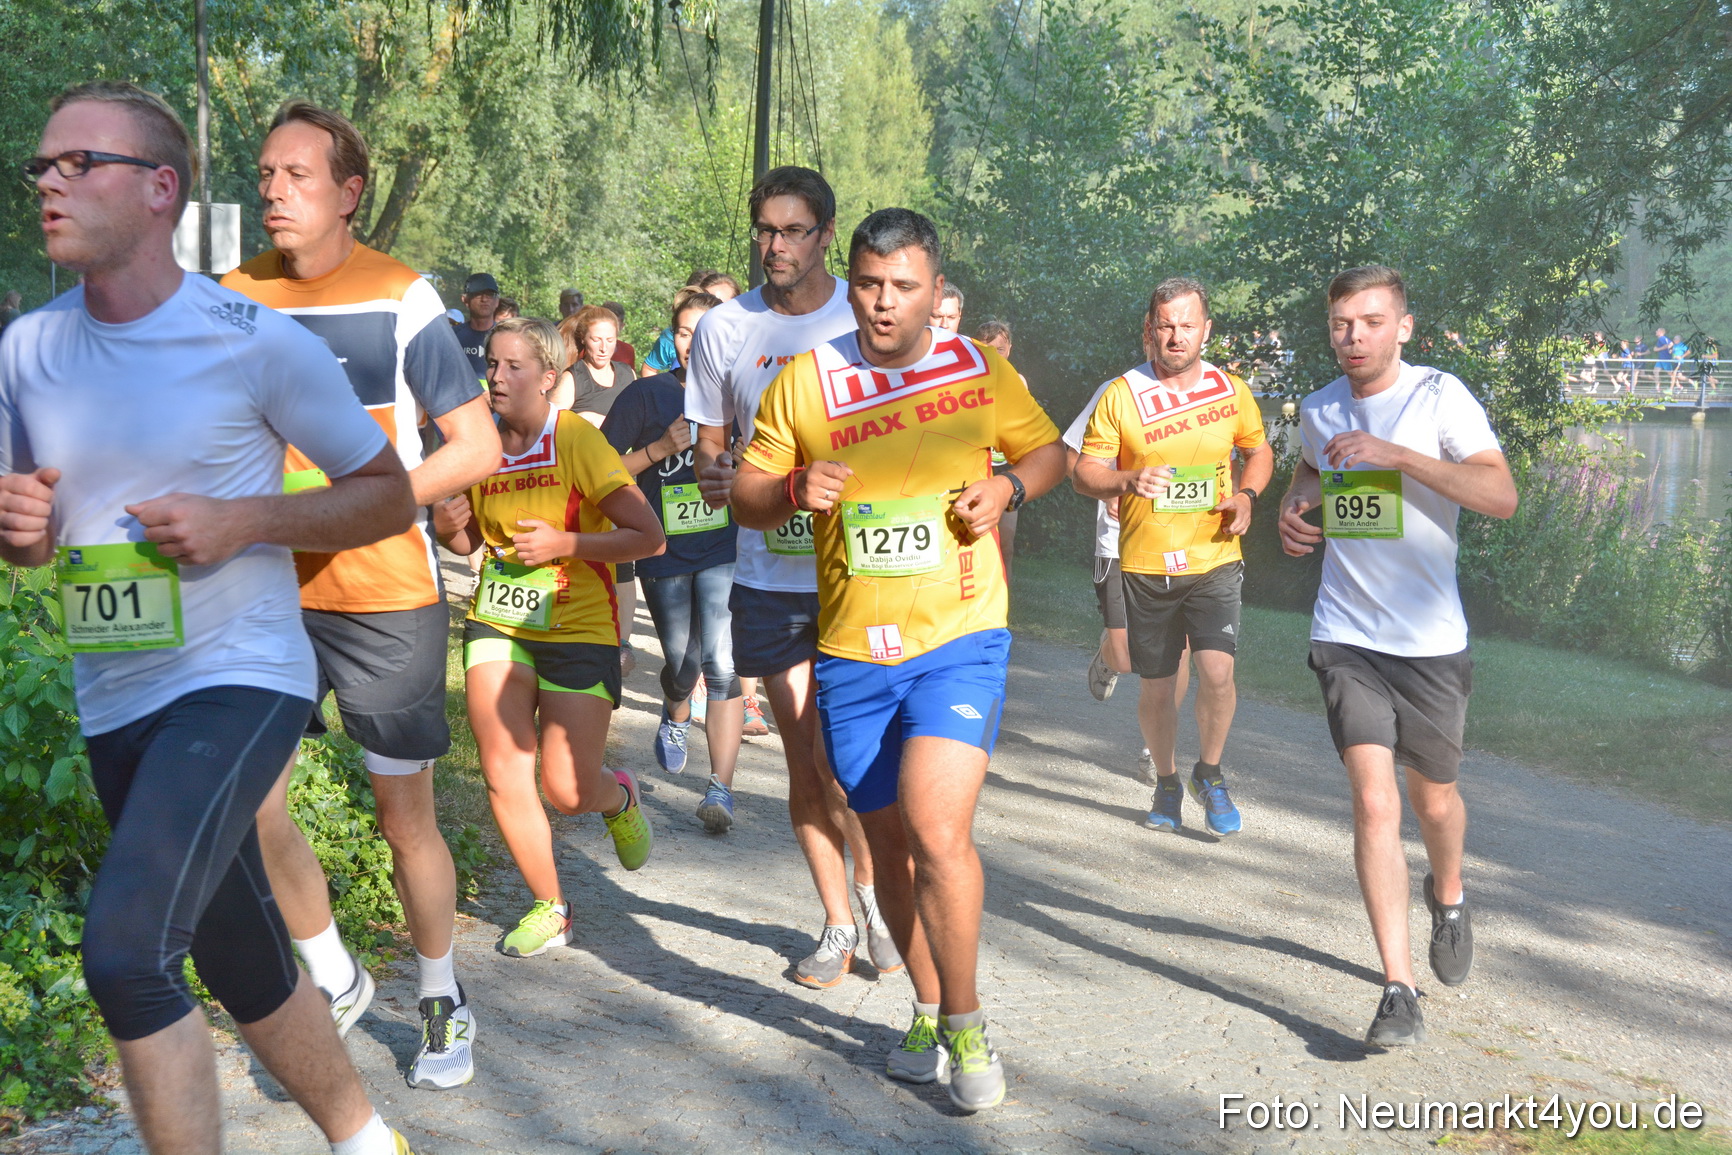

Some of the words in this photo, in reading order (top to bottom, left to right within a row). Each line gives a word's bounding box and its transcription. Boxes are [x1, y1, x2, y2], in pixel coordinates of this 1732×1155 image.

[210, 305, 257, 335] adidas
[829, 411, 908, 451] MAX
[914, 387, 994, 424] BÖGL
[1143, 418, 1192, 445] MAX
[1196, 403, 1239, 427] BÖGL
[480, 480, 511, 497] MAX
[515, 473, 561, 491] BÖGL
[1166, 481, 1208, 500] 1231
[677, 501, 713, 520] 270
[852, 512, 886, 520] firmenlauf
[1335, 495, 1382, 519] 695
[776, 537, 802, 545] Hollweck
[856, 524, 931, 554] 1279
[869, 555, 893, 565] Dabija
[895, 554, 921, 562] Ovidiu
[75, 581, 141, 622] 701
[487, 581, 540, 612] 1268
[491, 604, 511, 614] Bogner
[512, 609, 530, 618] Laura
[70, 624, 109, 634] Schneider
[113, 620, 166, 632] Alexander
